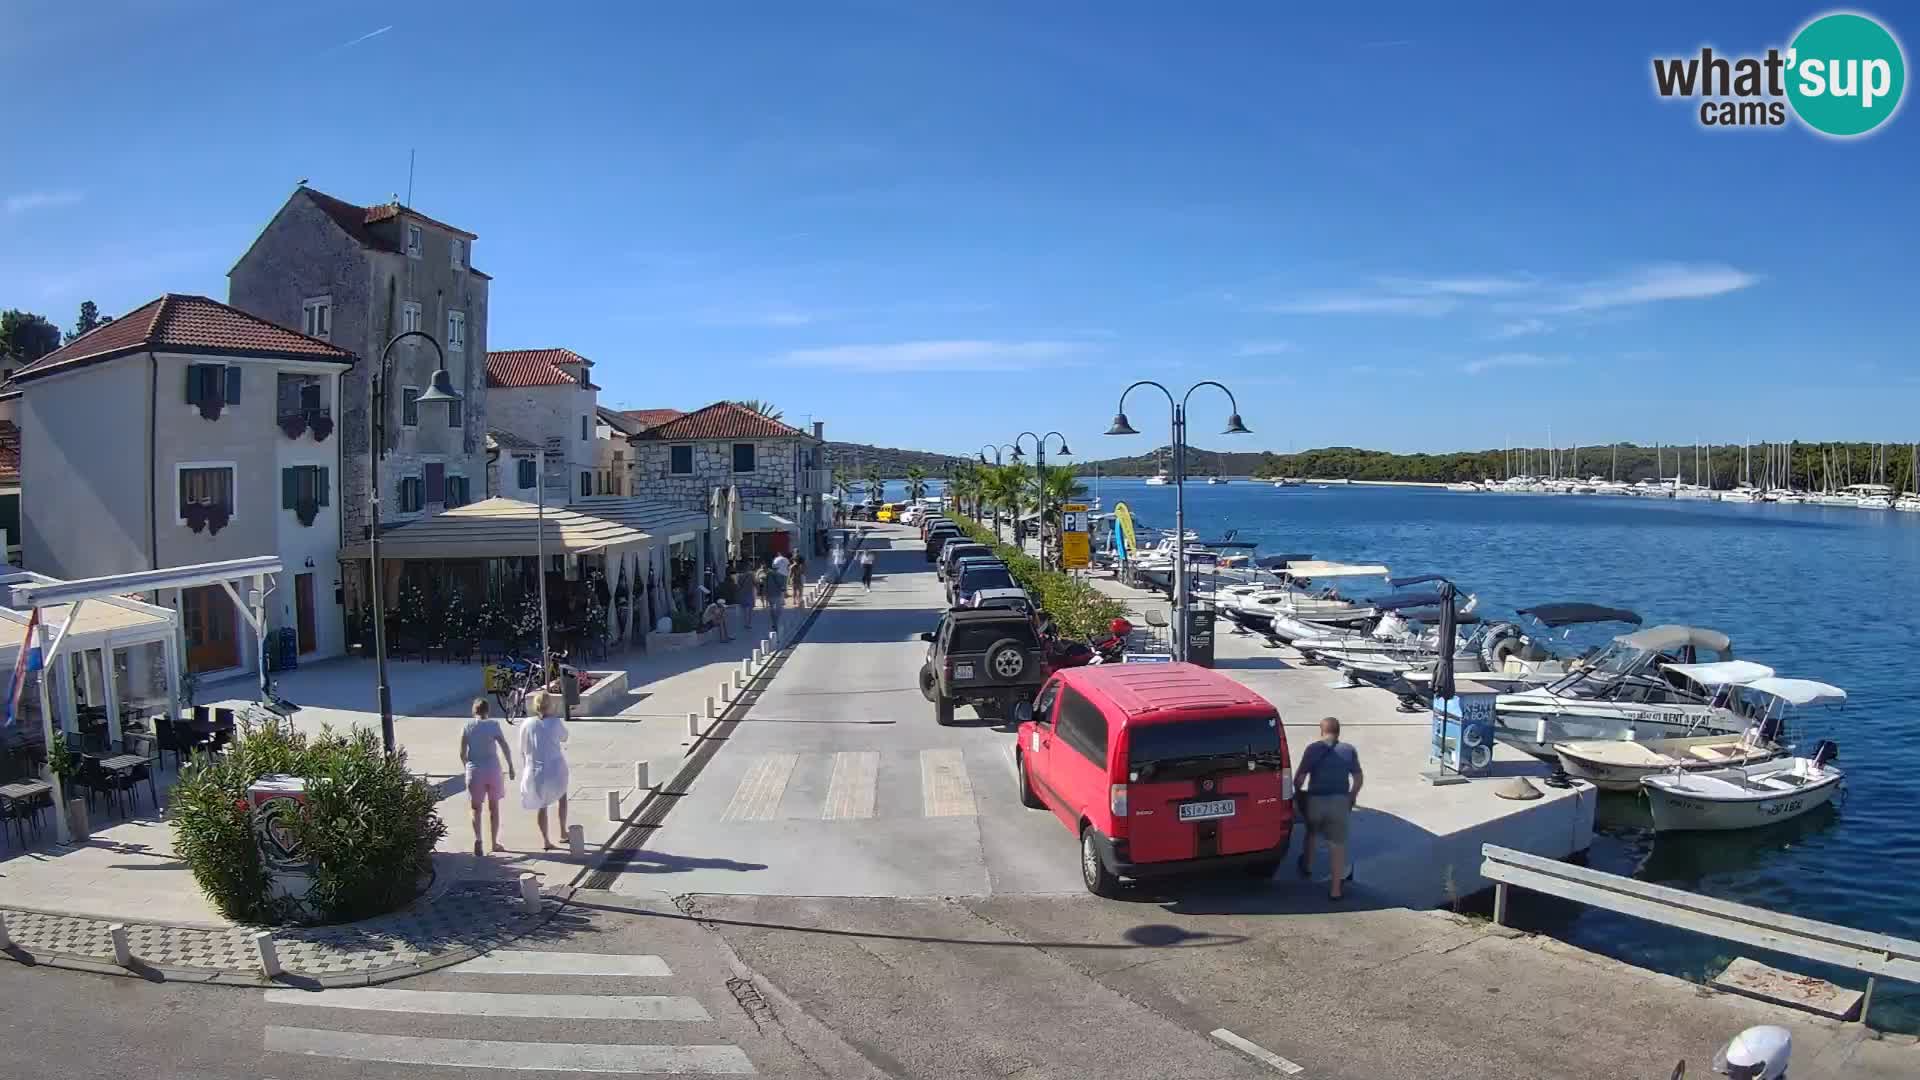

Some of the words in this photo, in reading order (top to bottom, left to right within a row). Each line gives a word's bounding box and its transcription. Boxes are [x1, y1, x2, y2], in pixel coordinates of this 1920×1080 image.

[1064, 514, 1075, 530] P
[1464, 698, 1493, 712] RENT
[1471, 710, 1493, 720] BOAT
[1663, 712, 1684, 724] RENT
